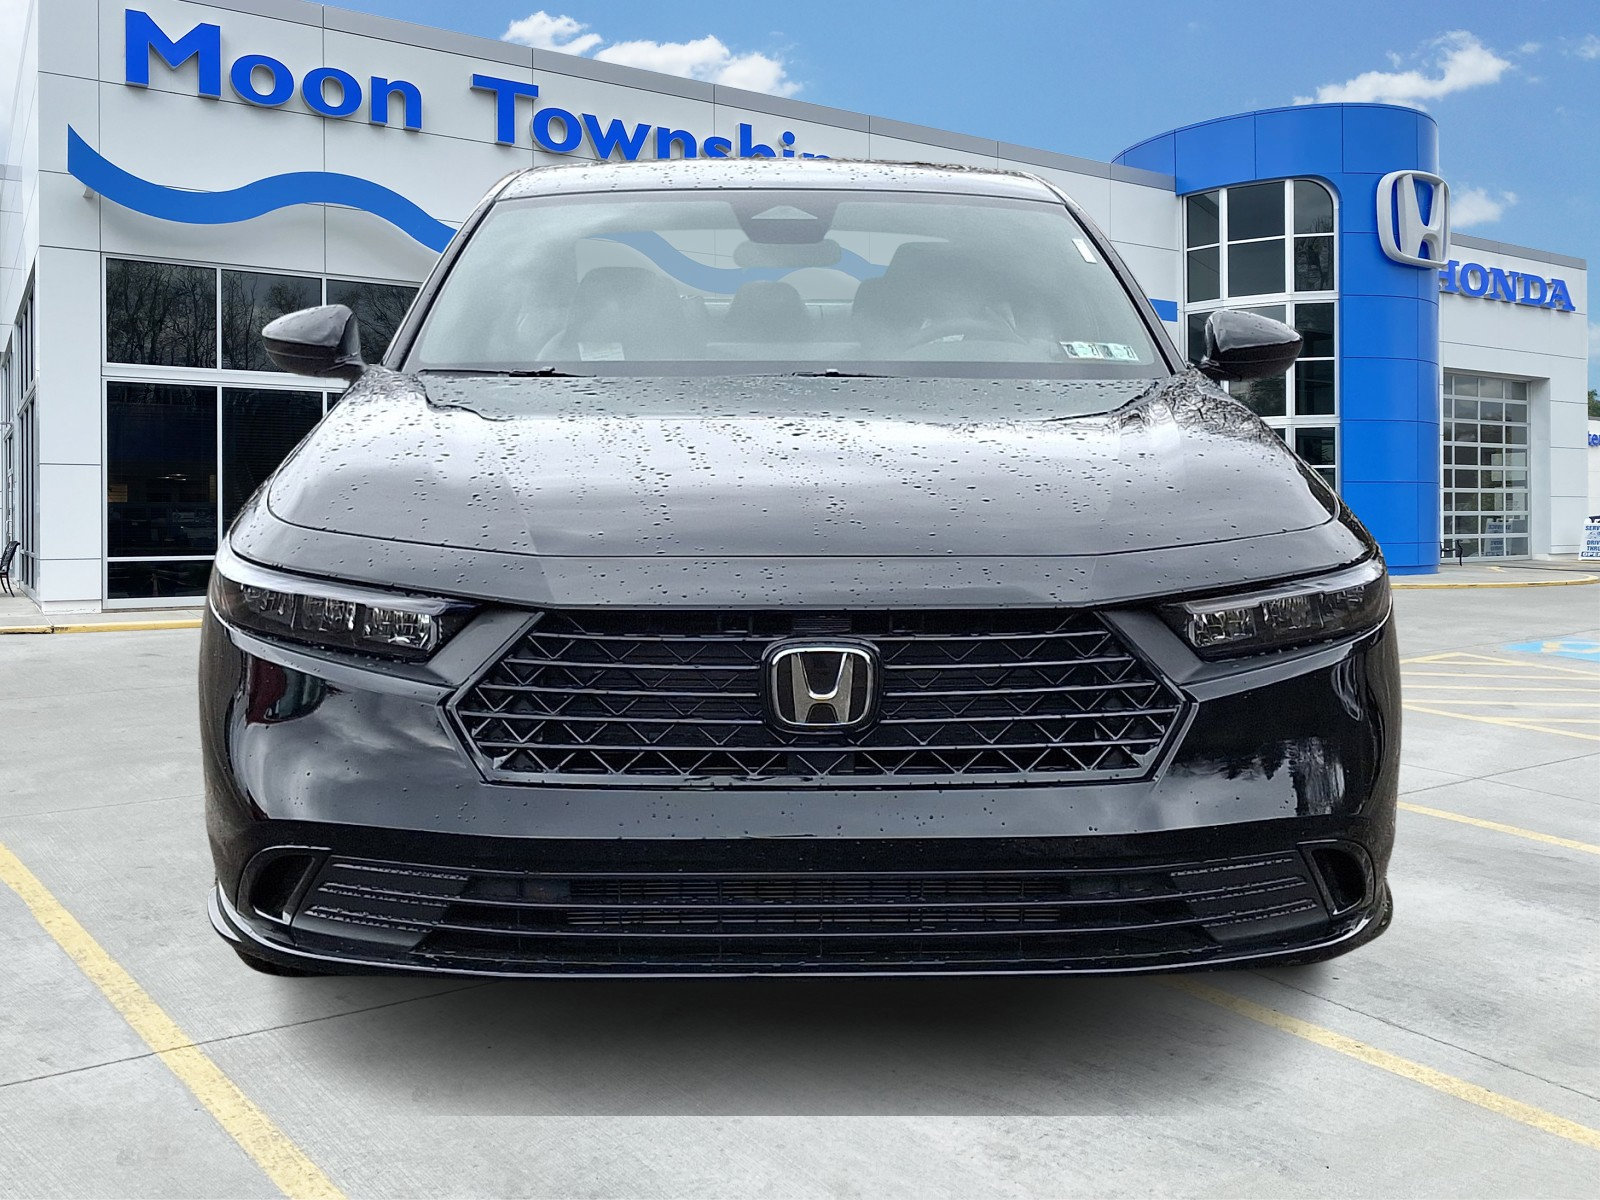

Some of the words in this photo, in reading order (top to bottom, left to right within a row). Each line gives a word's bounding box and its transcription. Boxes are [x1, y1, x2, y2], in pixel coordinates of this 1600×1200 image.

[125, 8, 422, 131] Moon
[470, 73, 831, 161] Townshi
[1439, 259, 1576, 312] HONDA
